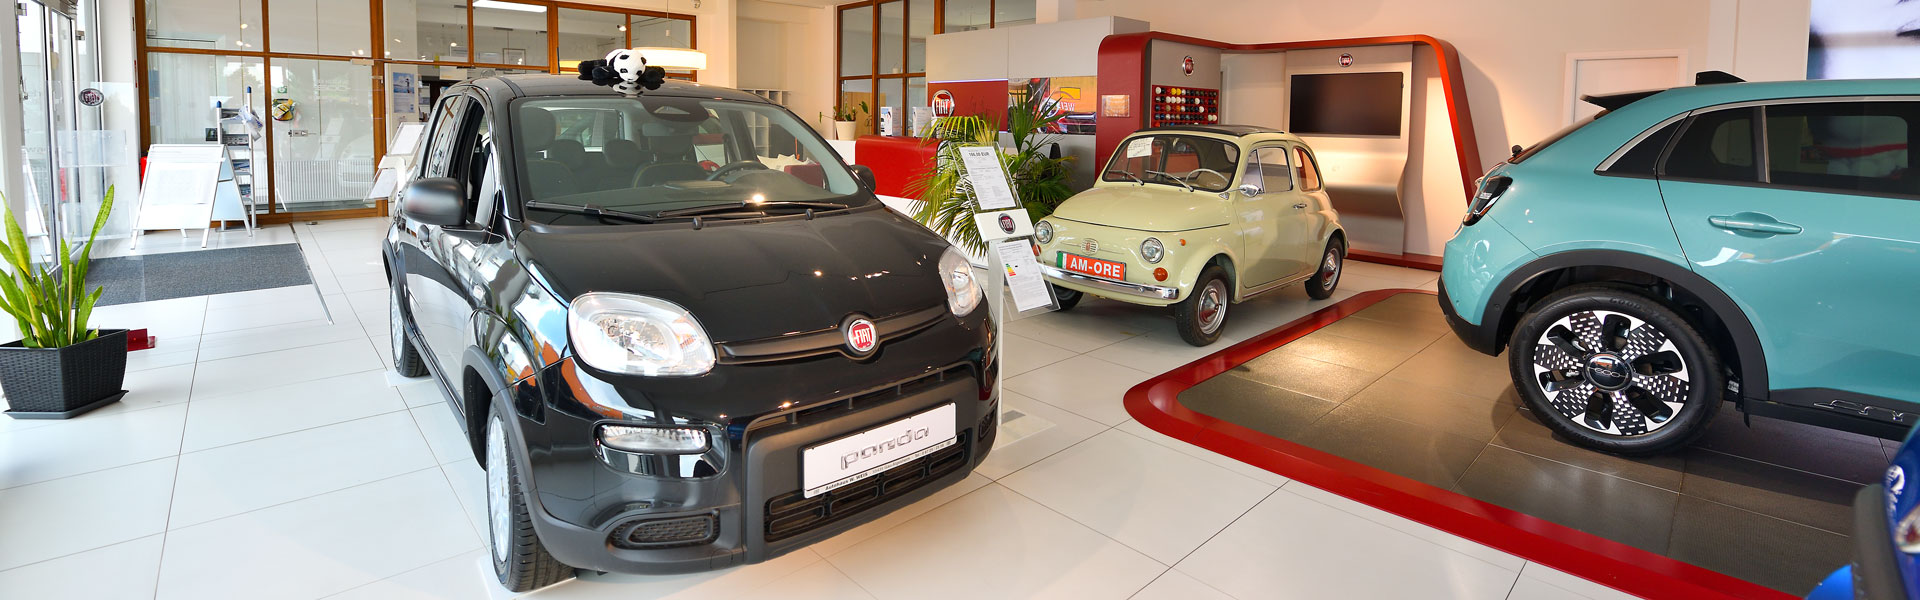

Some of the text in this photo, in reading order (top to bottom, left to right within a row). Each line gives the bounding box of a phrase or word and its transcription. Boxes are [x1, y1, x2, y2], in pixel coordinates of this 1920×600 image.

[935, 98, 950, 115] FIAT
[1070, 257, 1121, 278] AM-ORE
[855, 328, 870, 344] FIAT
[840, 426, 930, 471] panda
[825, 479, 849, 490] Autohaus
